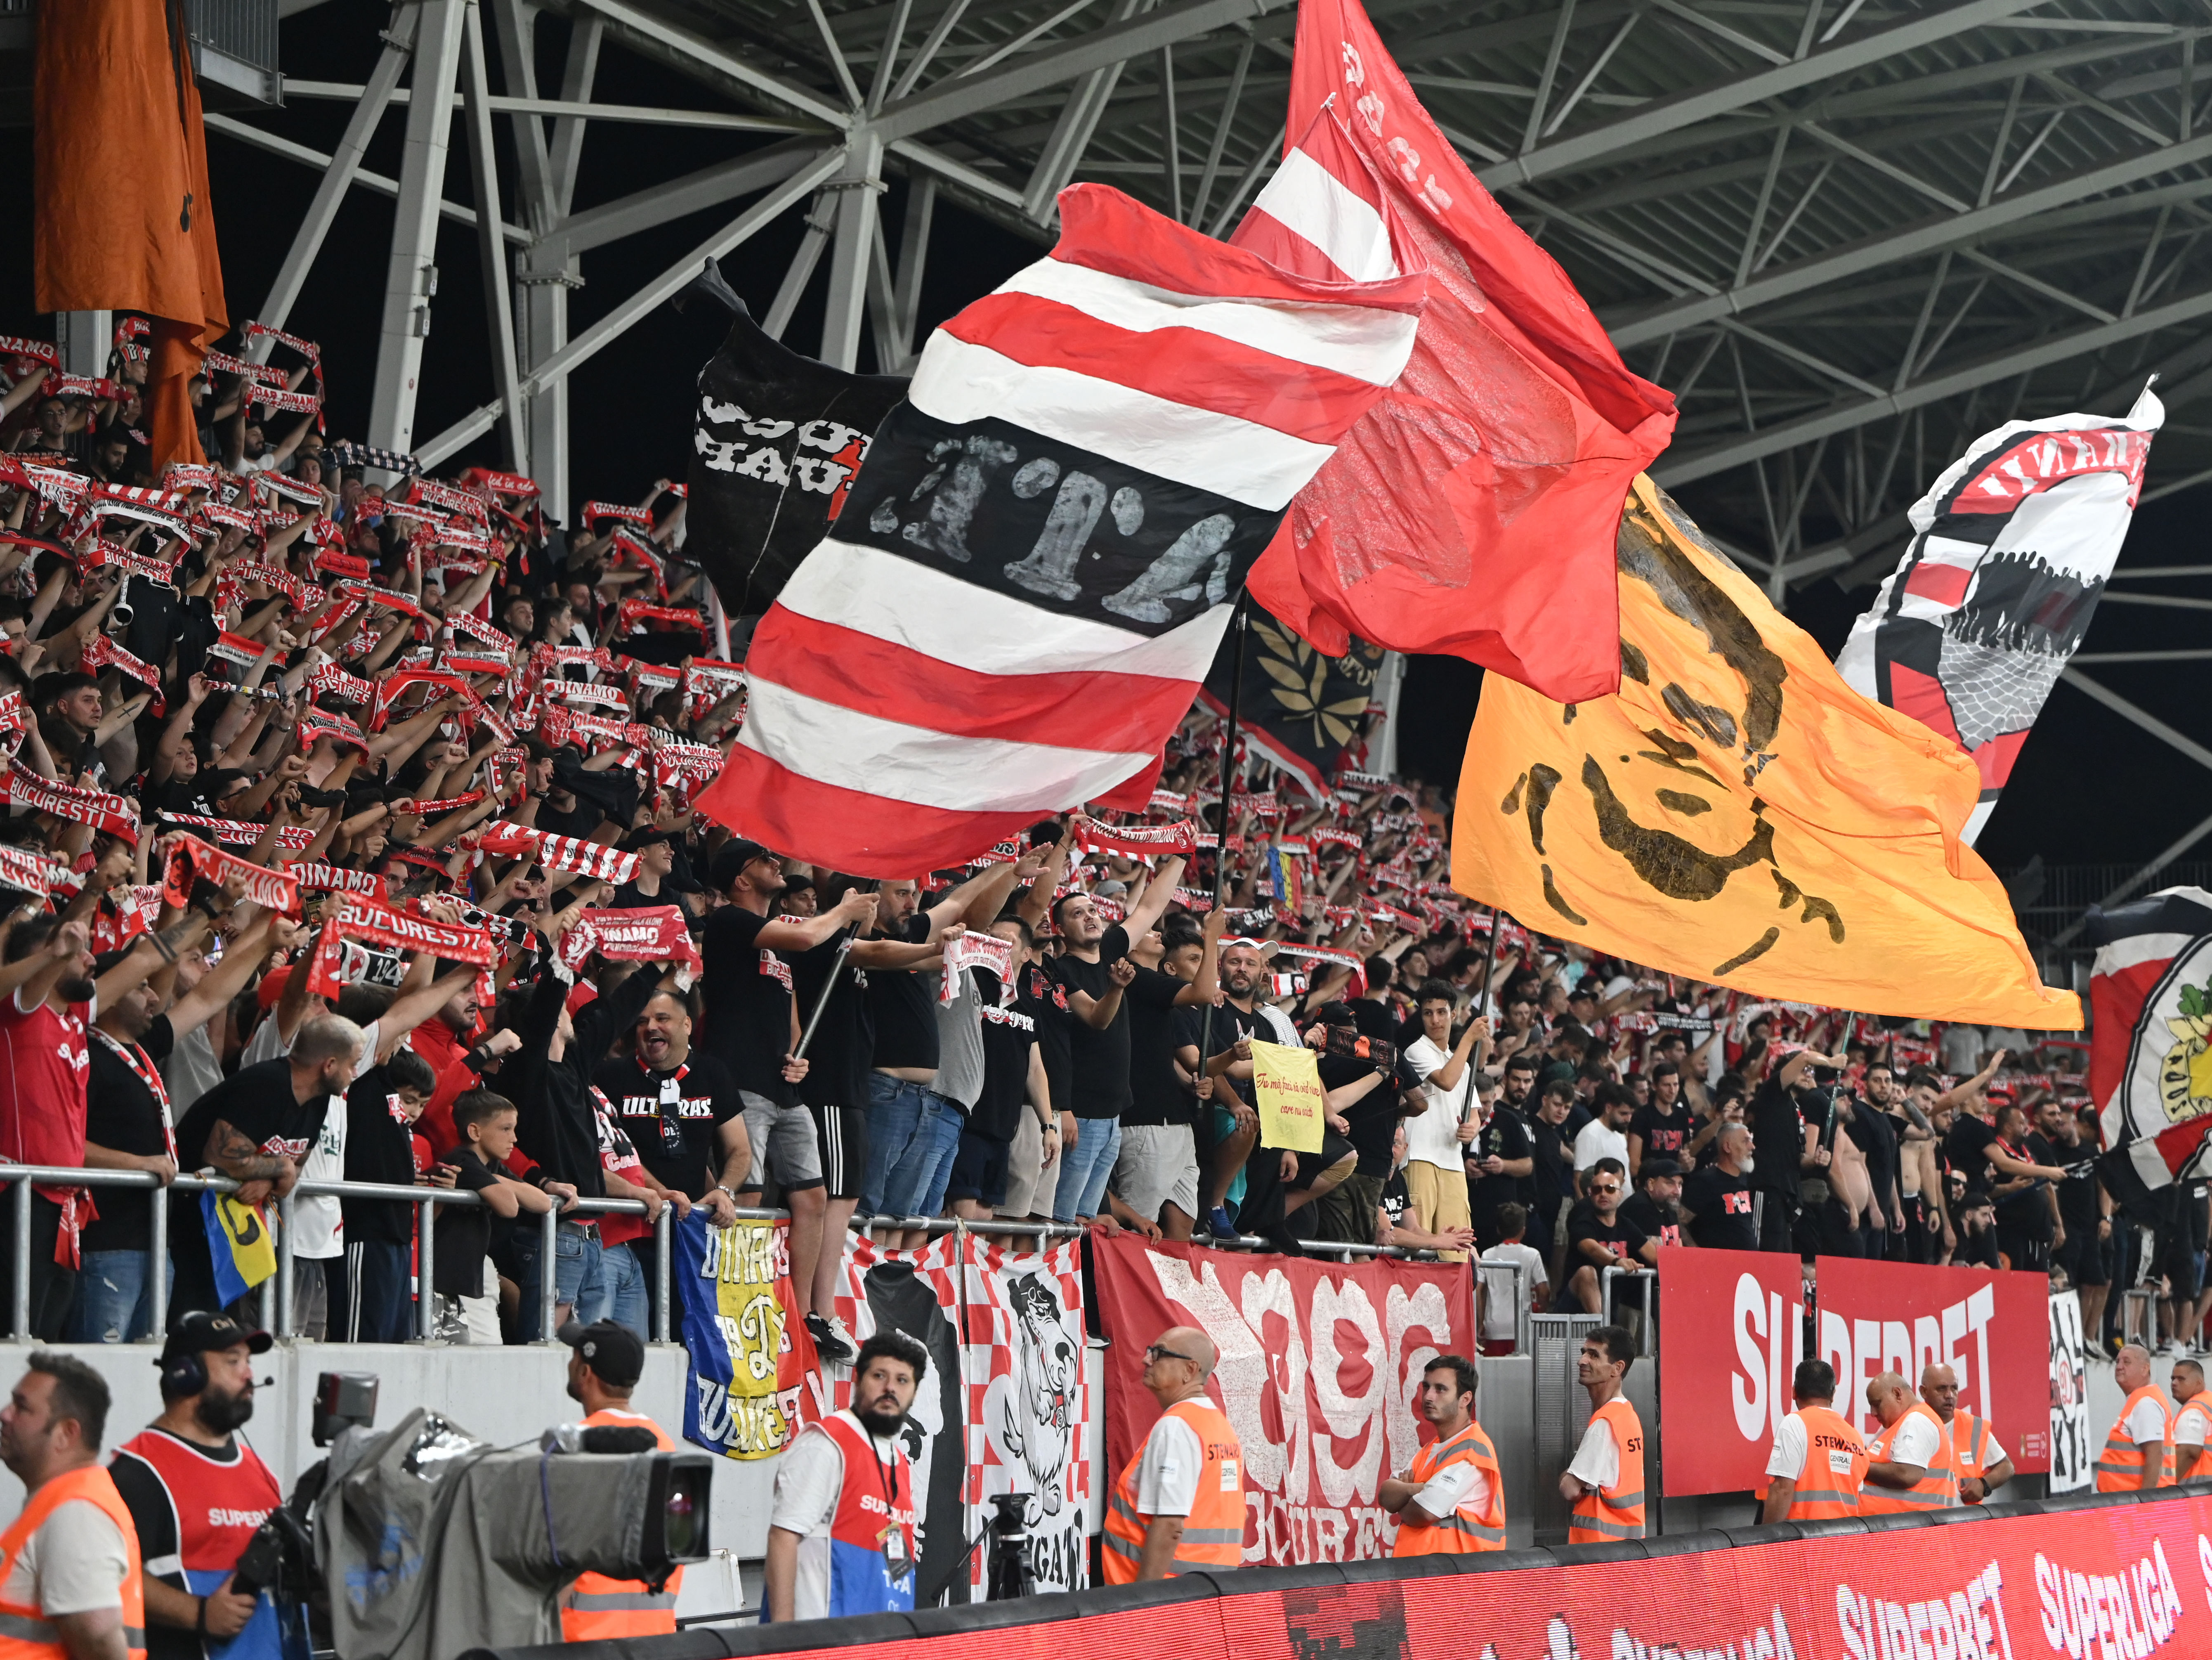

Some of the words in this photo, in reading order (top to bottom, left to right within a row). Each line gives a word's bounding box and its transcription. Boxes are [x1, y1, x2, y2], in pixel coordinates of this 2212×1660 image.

[0, 335, 54, 359] NAMO
[233, 566, 290, 594] CURESTI
[555, 681, 618, 701] DINAMO
[9, 776, 106, 829] BUCURESTI
[289, 863, 377, 897] DINAMO
[338, 904, 479, 951] BUCURESTI
[646, 917, 663, 927] ALONE
[372, 958, 403, 987] 194
[1256, 1073, 1269, 1088] Tu
[1280, 1105, 1294, 1115] care
[1295, 1107, 1302, 1116] nu
[701, 1223, 790, 1285] DINAMO
[1208, 1442, 1239, 1462] STEWAR
[1815, 1435, 1865, 1457] STEWARD
[208, 1508, 272, 1527] SUPERL
[2035, 1535, 2184, 1660] SUPERLIGA
